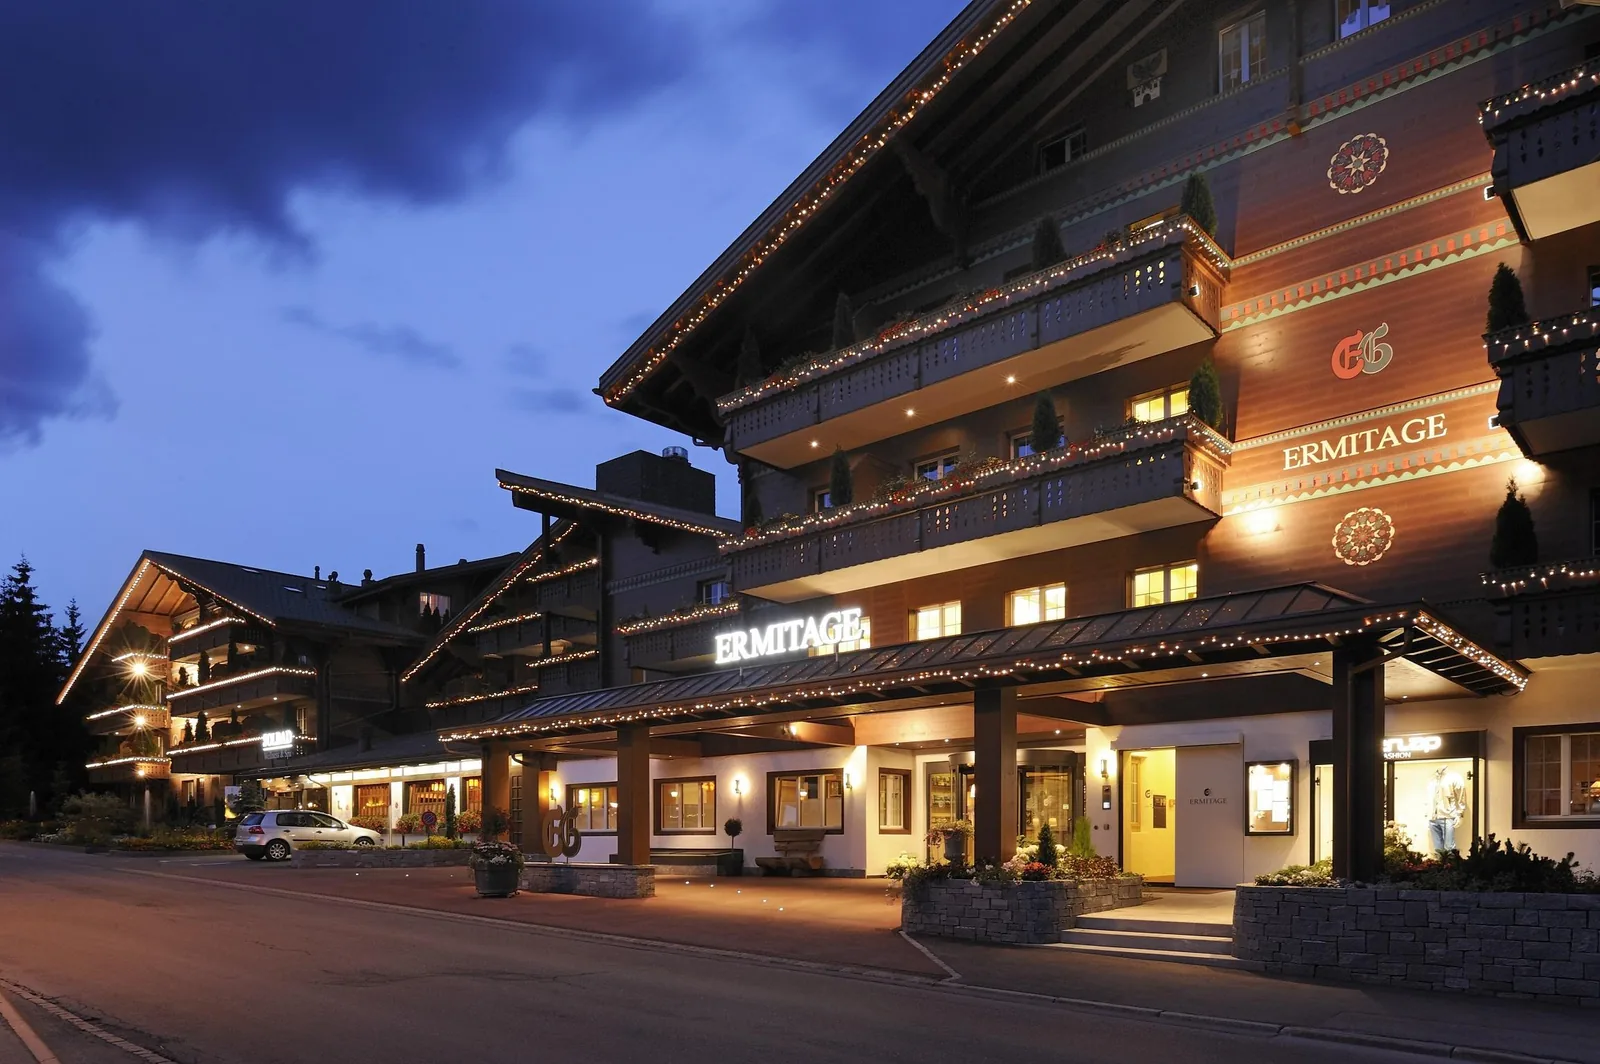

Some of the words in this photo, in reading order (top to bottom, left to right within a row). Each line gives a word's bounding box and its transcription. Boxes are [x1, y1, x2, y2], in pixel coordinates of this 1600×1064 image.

[1283, 413, 1448, 471] ERMITAGE
[714, 607, 866, 664] ERMITAGE
[1383, 751, 1412, 760] ASHION
[1189, 797, 1228, 806] ERMITAGE
